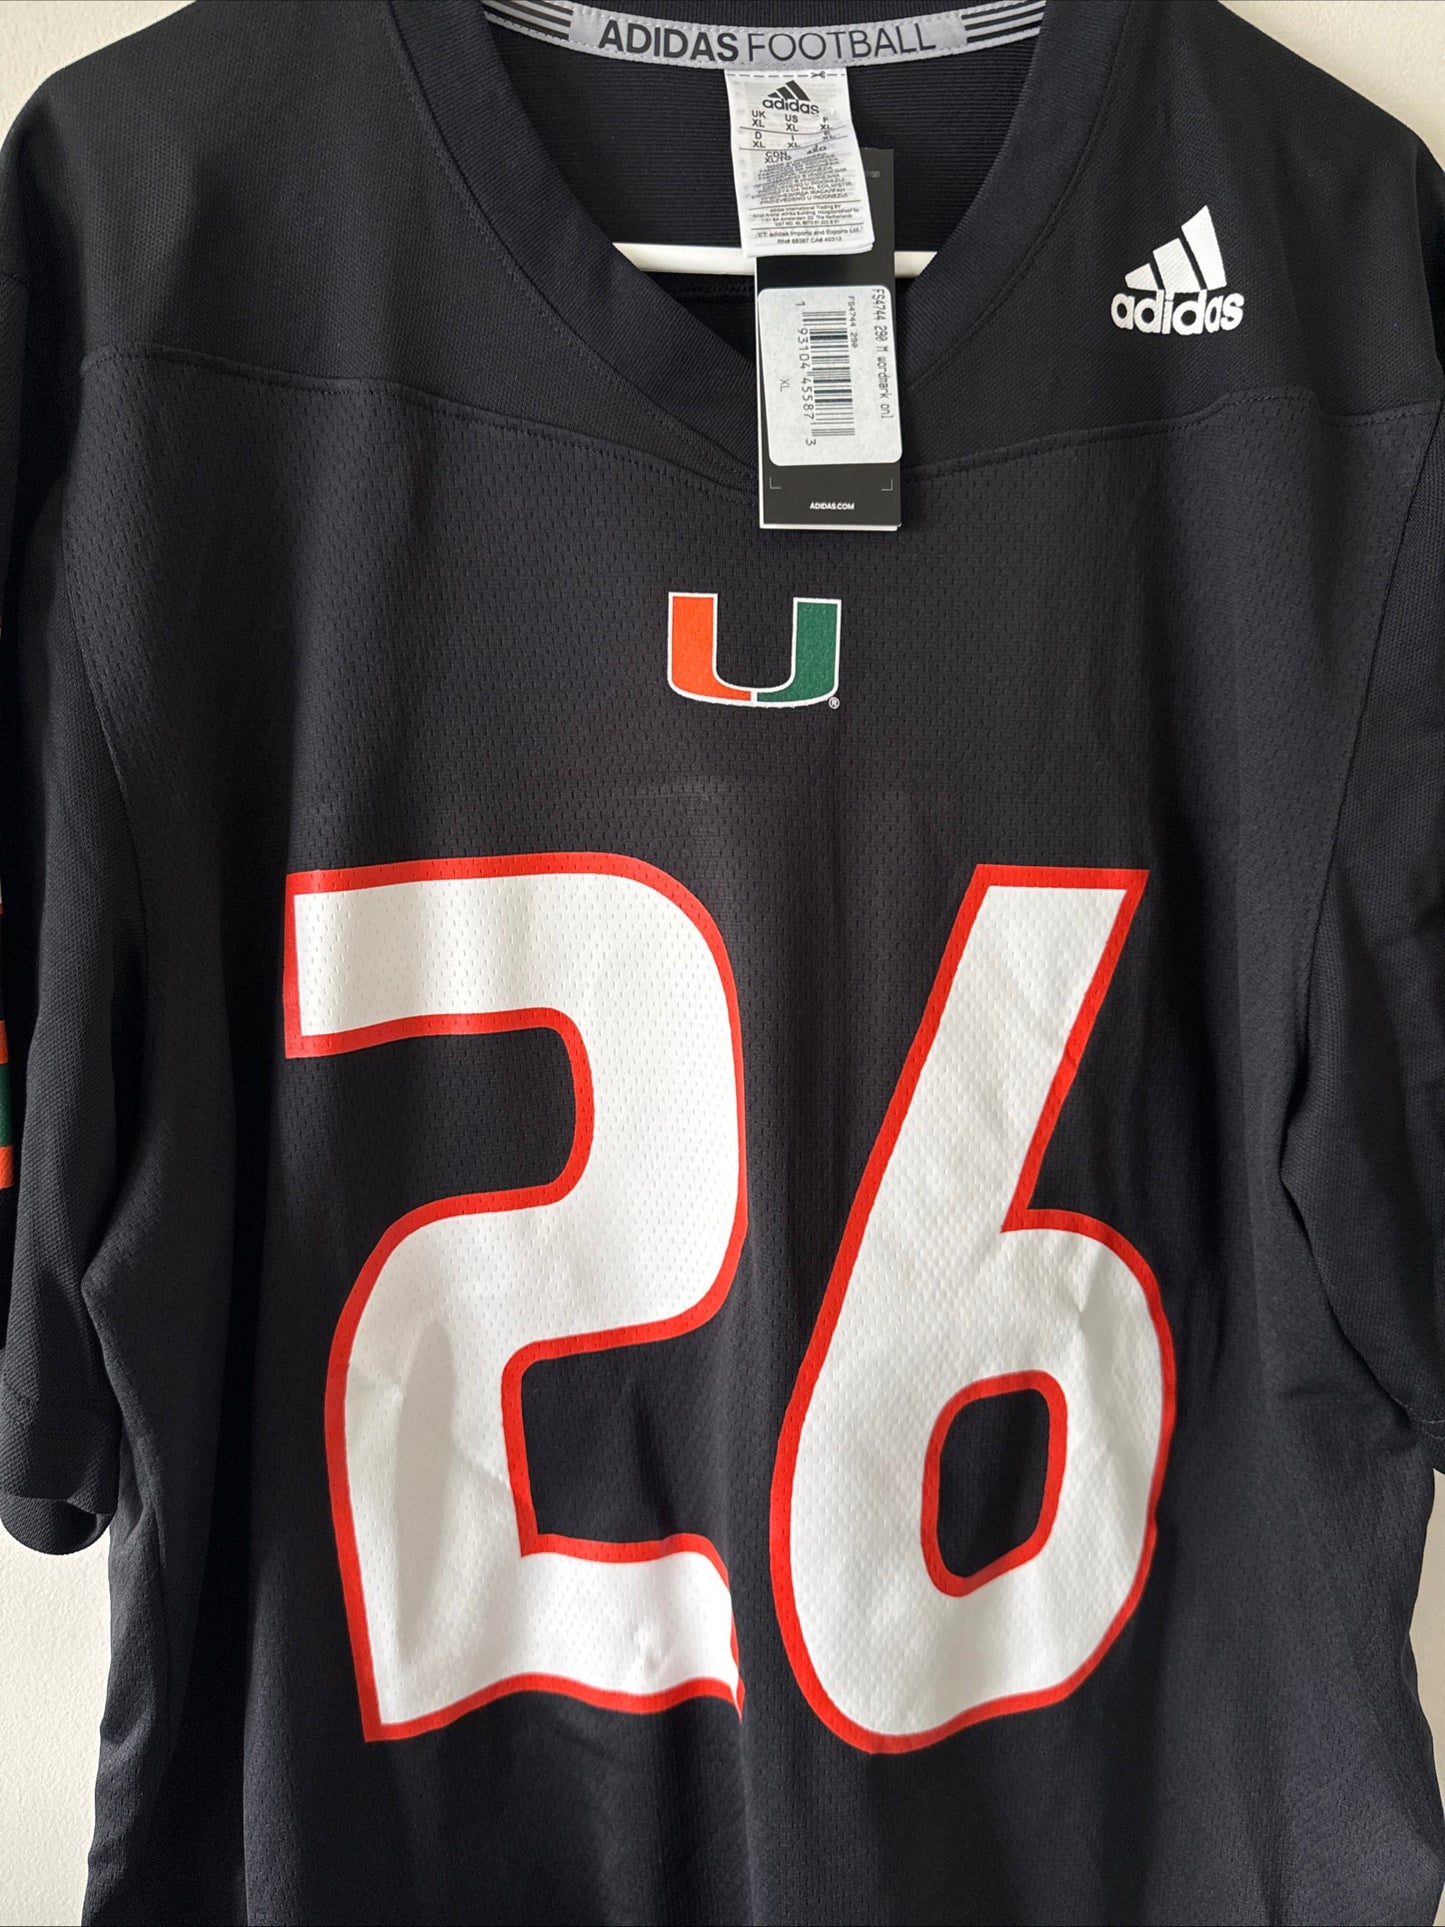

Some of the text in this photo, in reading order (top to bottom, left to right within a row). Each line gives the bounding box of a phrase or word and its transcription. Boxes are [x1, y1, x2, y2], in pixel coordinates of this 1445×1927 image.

[600, 19, 936, 61] ADIDAS FOOTBALL
[752, 110, 766, 119] UK
[785, 114, 798, 123] US
[762, 98, 820, 115] adidas
[752, 119, 765, 128] XL
[786, 123, 799, 132] XL
[755, 131, 762, 140] D
[872, 288, 886, 321] FS4744
[1111, 288, 1245, 336] adidas
[797, 328, 809, 370] 93104
[779, 378, 790, 393] XL
[801, 378, 815, 420] 45587
[809, 502, 855, 511] ADIDAS.COM
[667, 591, 842, 709] U
[285, 851, 1177, 1755] 26
